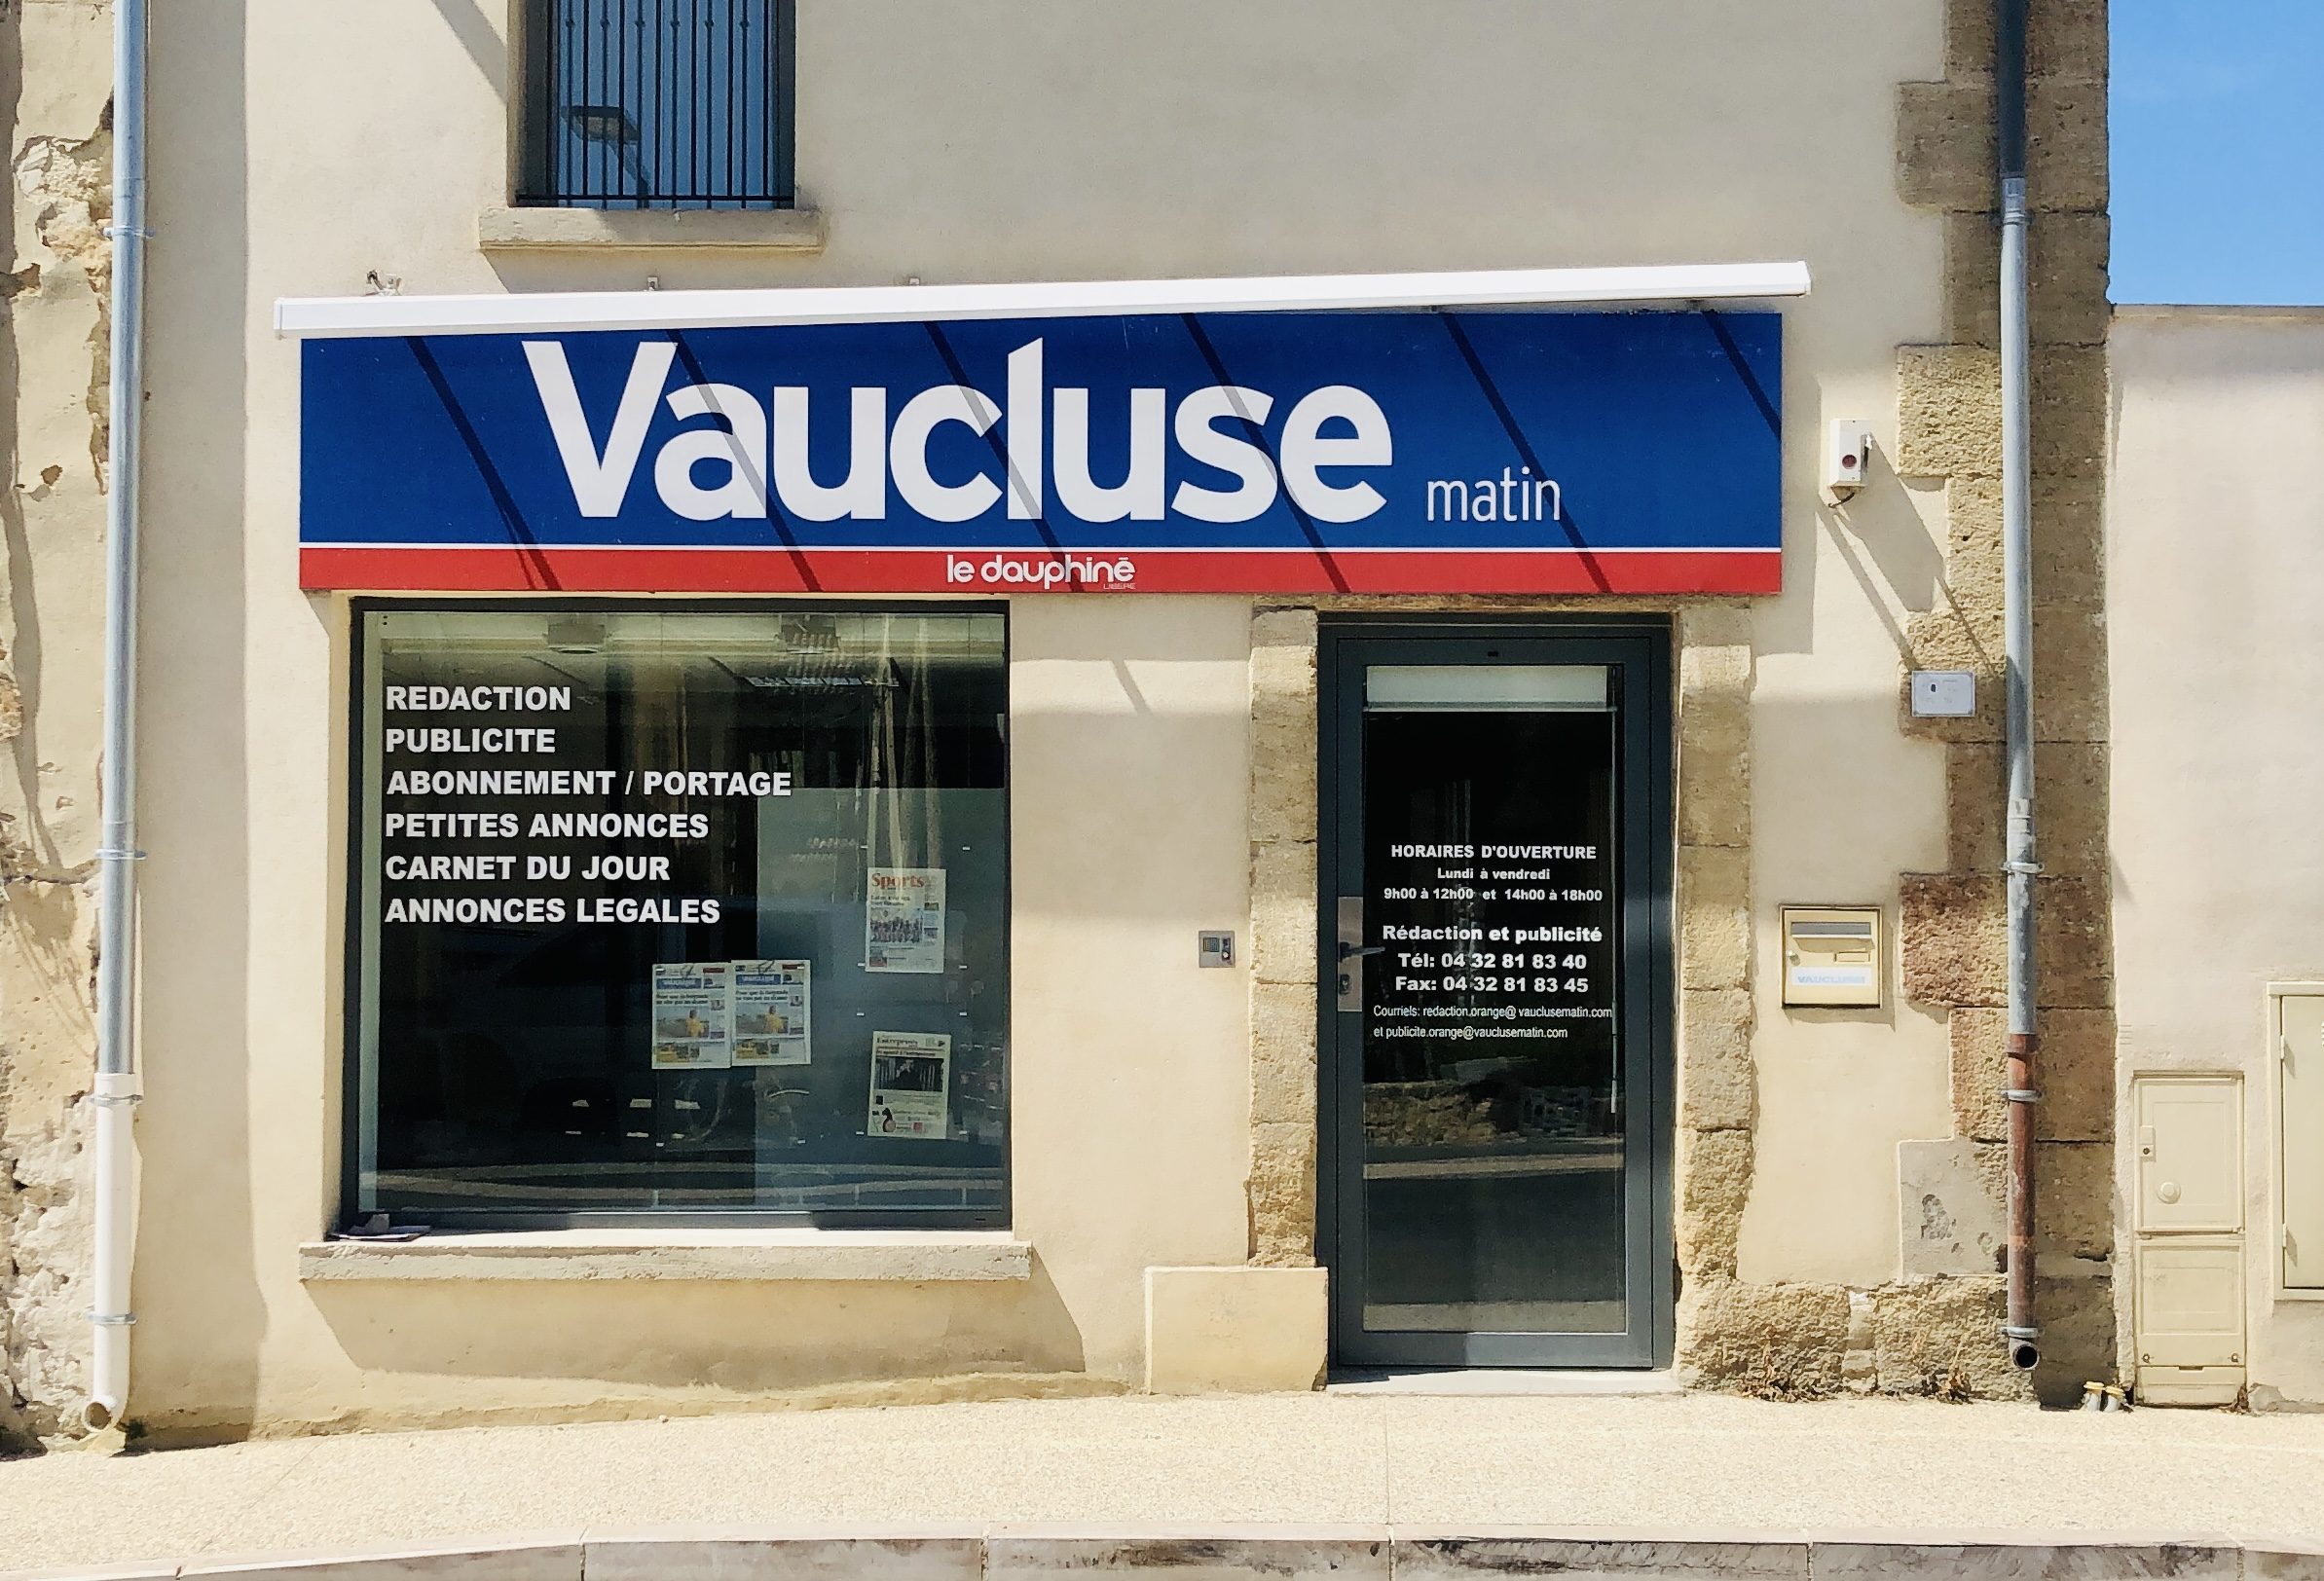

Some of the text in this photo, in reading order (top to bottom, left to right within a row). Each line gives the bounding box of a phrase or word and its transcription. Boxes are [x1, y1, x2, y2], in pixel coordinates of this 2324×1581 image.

[522, 337, 1562, 524] Vaucluse matin
[947, 554, 976, 583] le
[386, 685, 571, 711] REDACTION
[386, 728, 556, 753] PUBLICITE
[387, 770, 616, 795] ABONNEMENT
[644, 771, 792, 796] PORTAGE
[386, 813, 709, 838] PETITES ANNONCES
[1391, 844, 1597, 860] HORAIRES D'OUVERTURE
[386, 856, 671, 881] CARNET DU JOUR
[1437, 867, 1551, 880] Lundi à vendredi
[1383, 887, 1603, 901] 9h00 à 12h00 et 14h00 à 18h00
[385, 898, 720, 924] ANNONCES LEGALES
[1383, 924, 1603, 944] Rédaction et publicité
[1397, 952, 1587, 970] Tél: 04 32 81 83 40
[1395, 975, 1589, 993] Fax: 04 32 81 83 45
[1373, 1005, 1420, 1017] Courriels:
[1519, 1005, 1612, 1019] vauclusematin.com
[1373, 1026, 1383, 1038] et
